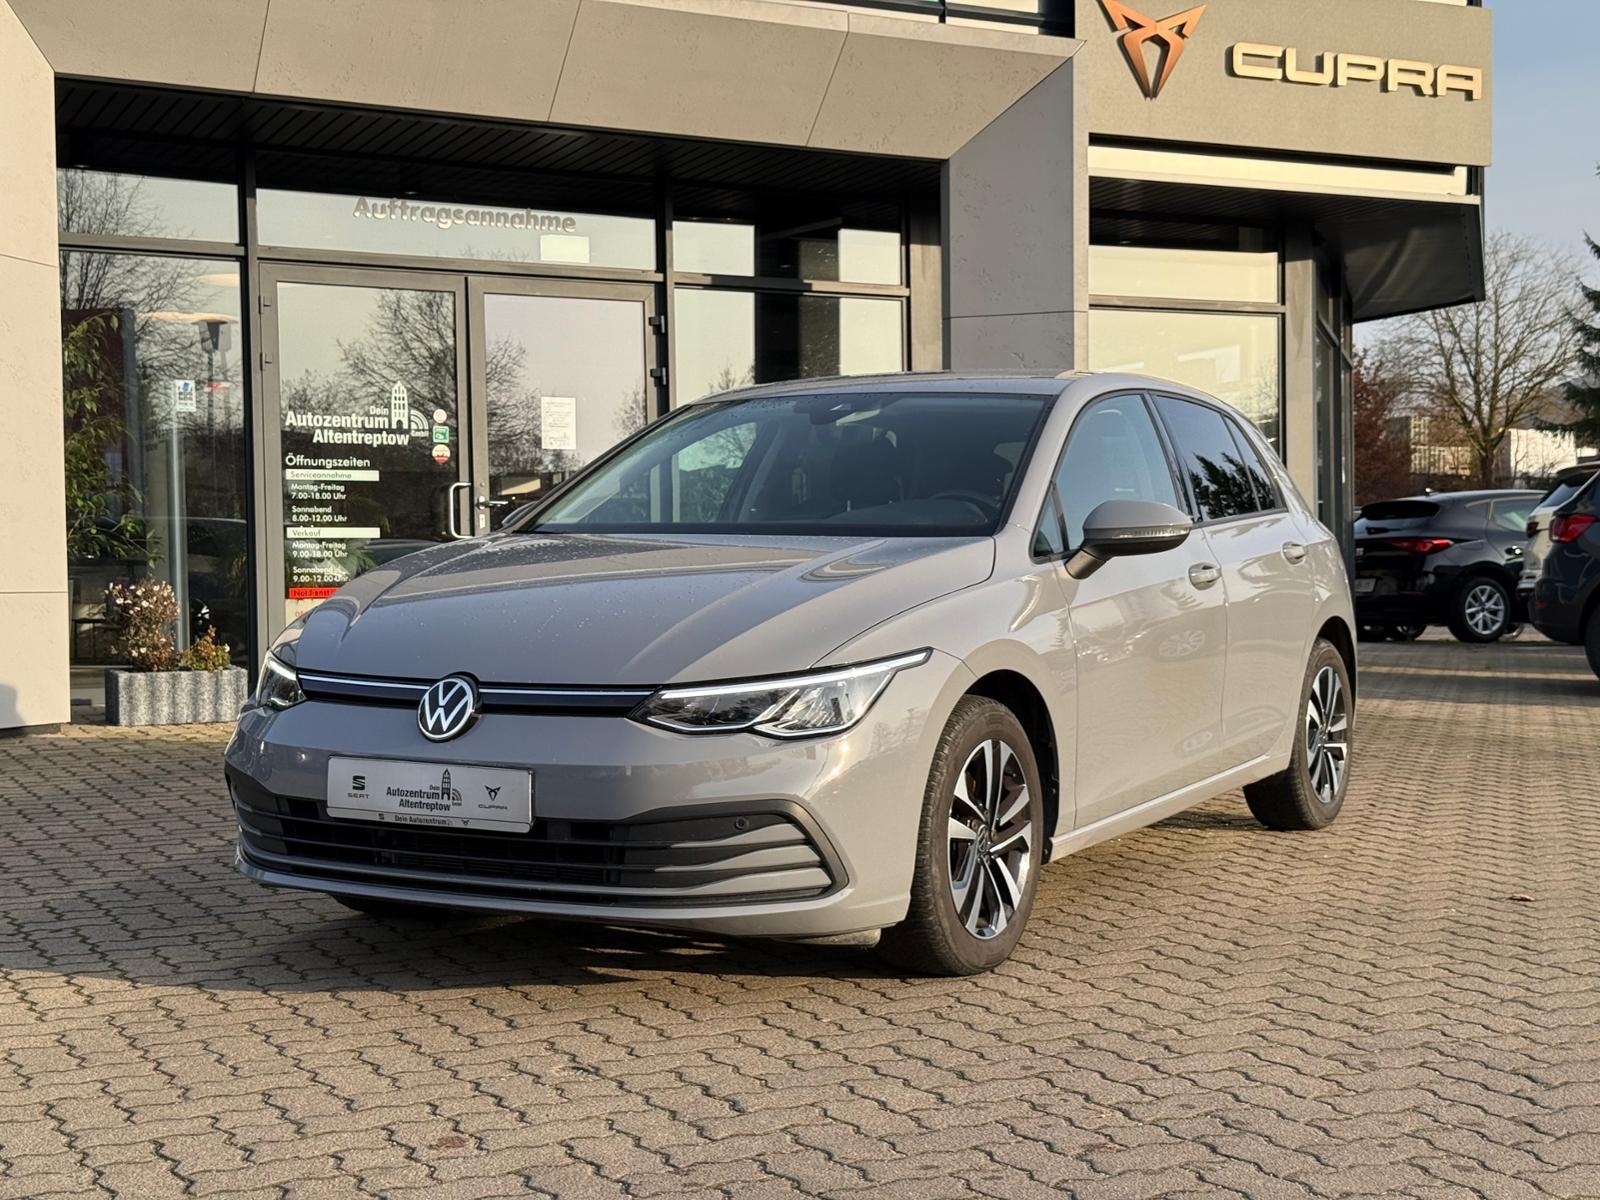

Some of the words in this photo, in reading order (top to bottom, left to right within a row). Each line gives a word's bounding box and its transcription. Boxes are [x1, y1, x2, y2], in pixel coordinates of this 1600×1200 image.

[1231, 42, 1482, 99] CUPRA
[353, 197, 576, 232] Auftragsannahme
[370, 406, 389, 415] Dein
[285, 411, 389, 429] Autozentrum
[312, 429, 409, 447] Altentreptow
[285, 452, 371, 468] Öffnungszeiten
[290, 471, 352, 479] Serviceannahme
[291, 483, 345, 492] Montag-Freitag
[291, 492, 332, 500] 7.00-18.00
[333, 492, 347, 500] Uhr
[291, 505, 332, 513] Sonnabend
[291, 514, 332, 522] 8.00-12.00
[334, 514, 348, 522] Uhr
[292, 529, 321, 537] Verkauf
[292, 541, 346, 550] Montag-Freitag
[292, 550, 333, 558] 9.00-18.00
[334, 549, 348, 558] Uhr
[292, 566, 333, 574] Sonnabend
[386, 786, 440, 800] Autozentrum
[399, 798, 451, 812] Altentreptow
[395, 814, 409, 823] Dein
